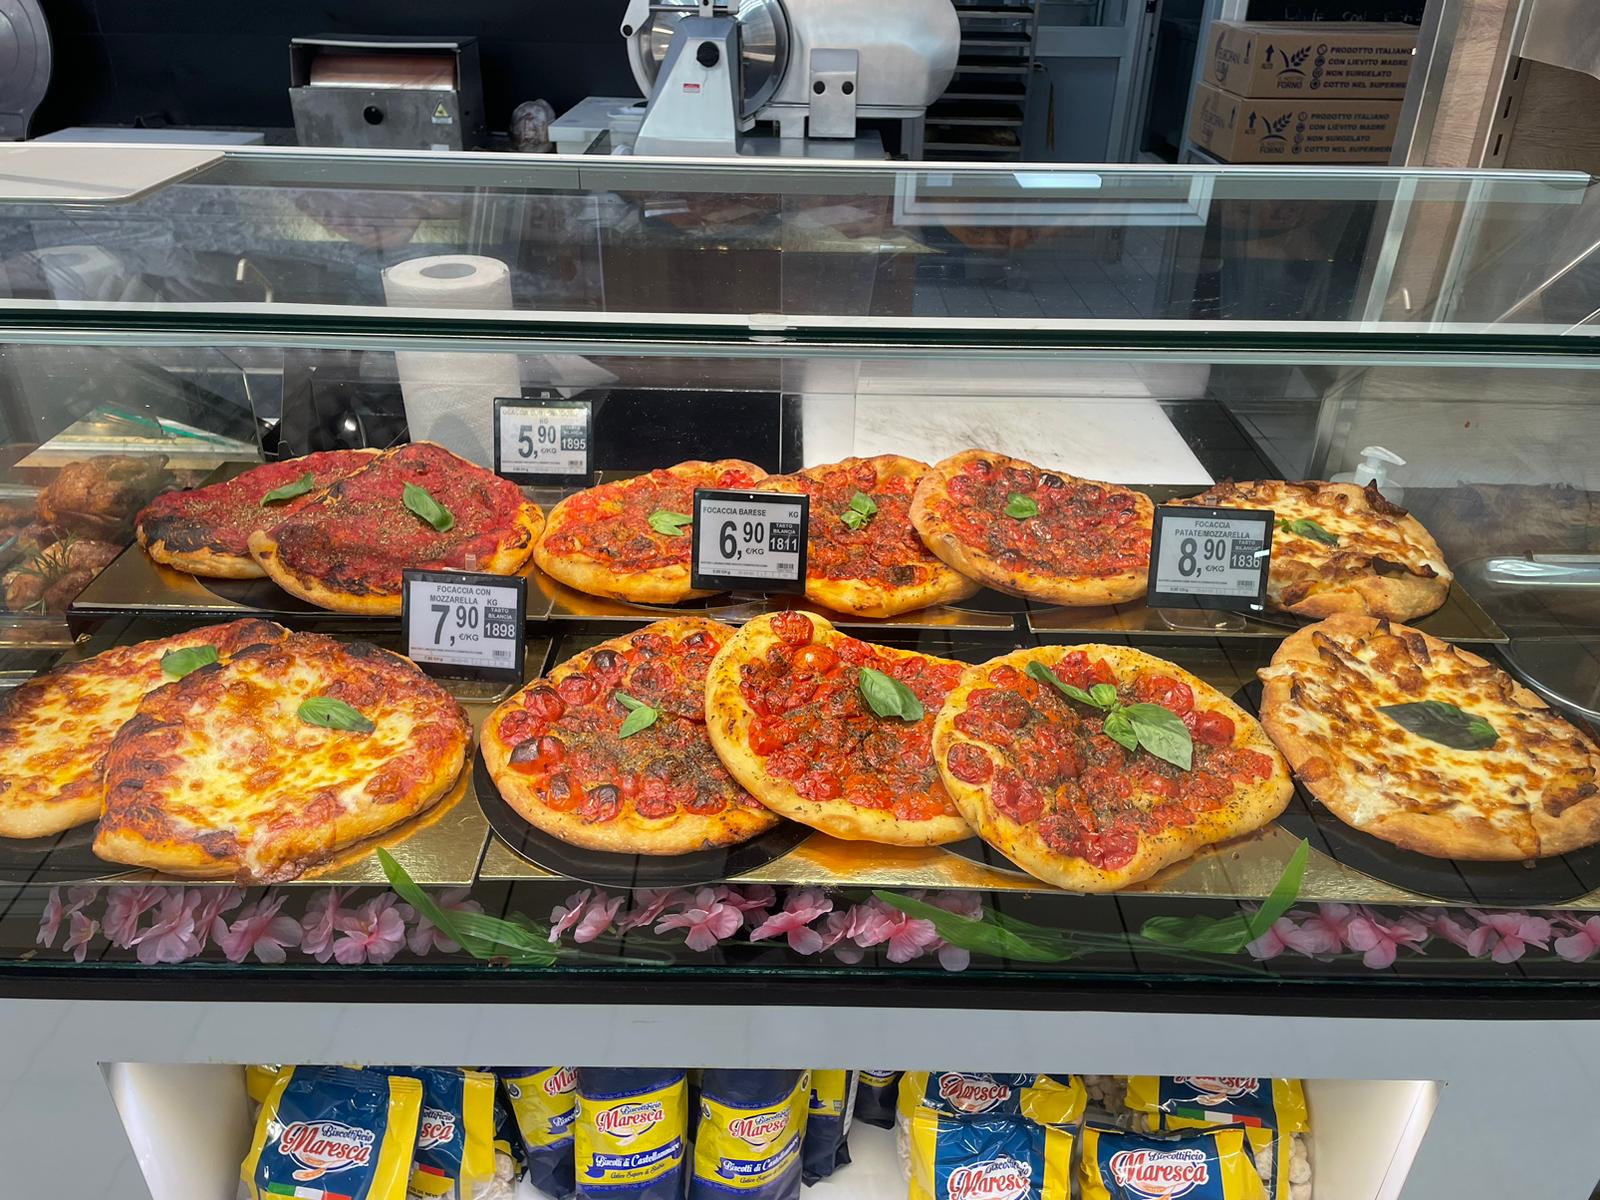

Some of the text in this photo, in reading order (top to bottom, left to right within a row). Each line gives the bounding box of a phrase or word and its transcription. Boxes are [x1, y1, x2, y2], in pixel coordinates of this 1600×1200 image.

[1330, 47, 1412, 55] PRODOTTO ITALIANO
[1328, 58, 1345, 66] CON
[1347, 58, 1378, 66] LIEVITO
[1277, 81, 1302, 89] FORNO
[1260, 146, 1284, 154] FORNO
[561, 438, 586, 450] 1895
[703, 506, 737, 516] FOCACCIA
[738, 508, 766, 517] BARESE
[1194, 520, 1230, 529] FOCACCIA
[770, 538, 798, 551] 1811
[1232, 554, 1260, 568] 1836
[436, 585, 491, 596] FOCACCIA CON
[430, 594, 478, 605] MOZZARELLA
[485, 623, 515, 638] 1898
[458, 634, 479, 642] €/KG
[723, 1160, 752, 1173] Biscotti
[754, 1164, 762, 1172] di
